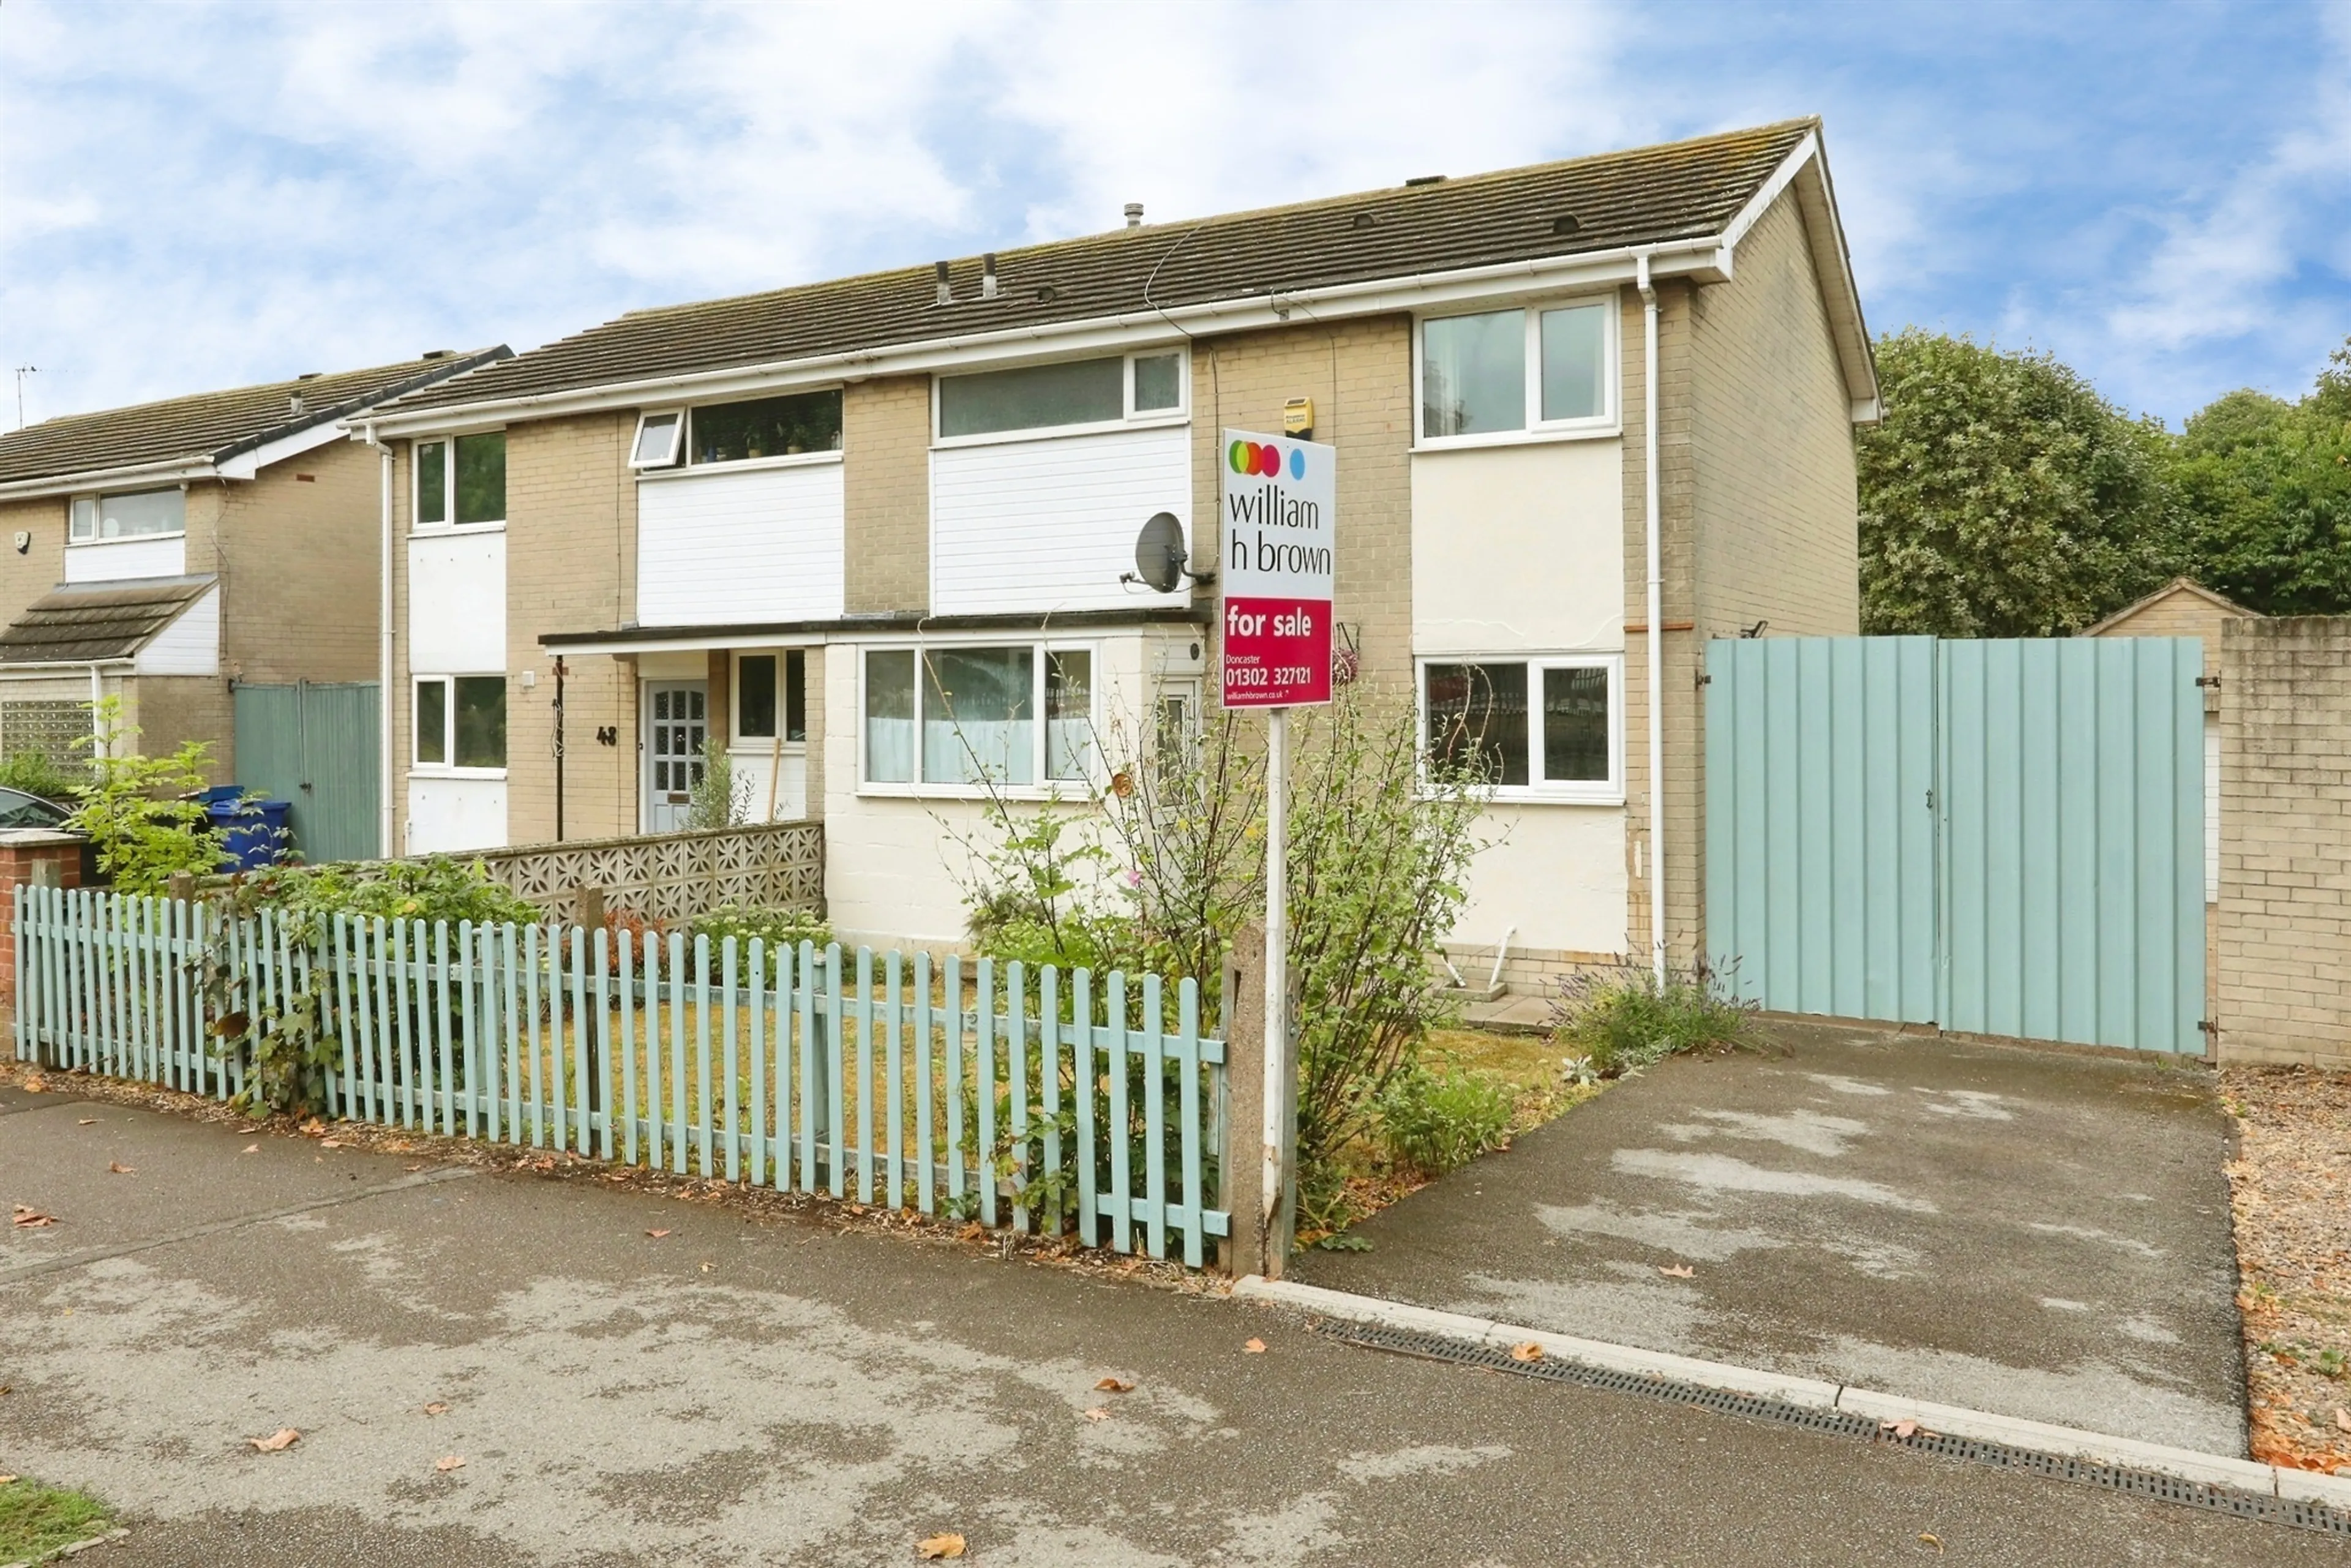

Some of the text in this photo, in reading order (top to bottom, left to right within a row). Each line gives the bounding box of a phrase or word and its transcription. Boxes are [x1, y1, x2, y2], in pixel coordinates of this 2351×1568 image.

[1229, 484, 1319, 530] william
[1232, 529, 1330, 575] h brown
[1228, 605, 1311, 637] for sale
[1226, 654, 1261, 664] Doncaster
[1226, 667, 1311, 686] 01302 327121
[1226, 690, 1283, 700] williamhbrown.co.uk
[596, 726, 617, 746] 48
